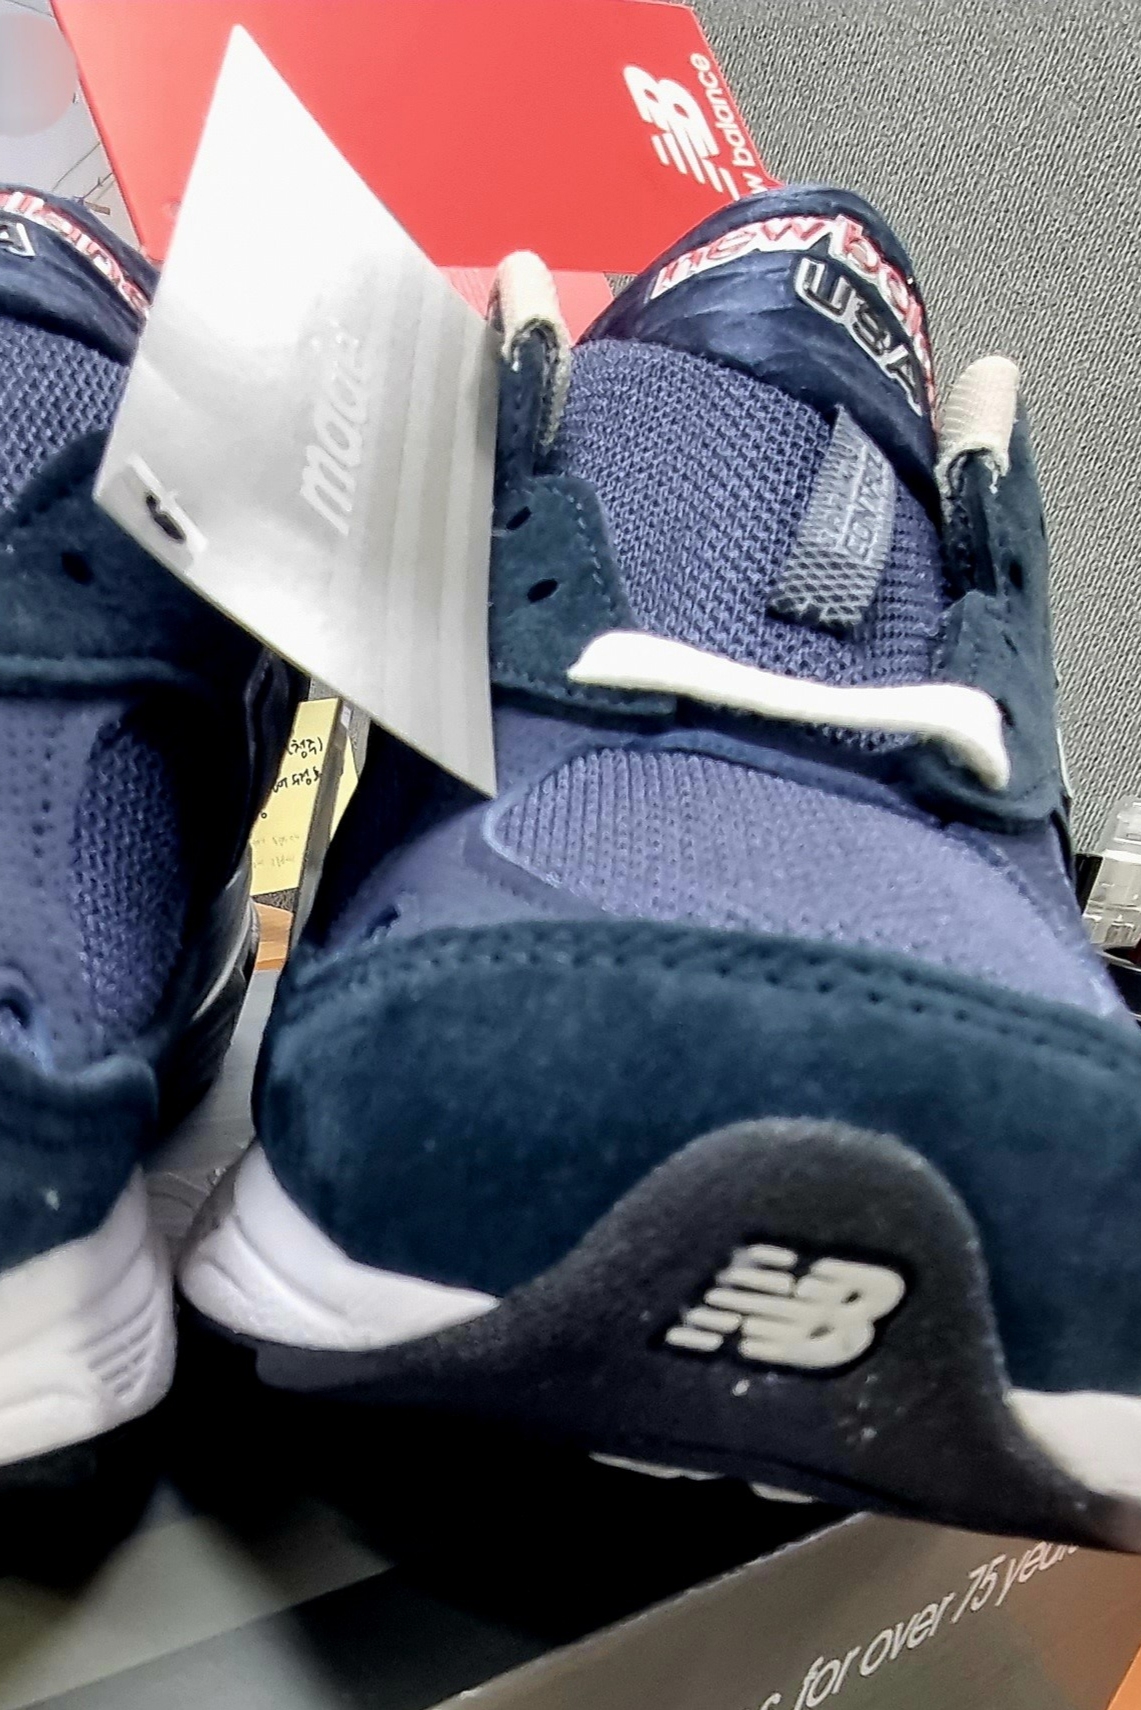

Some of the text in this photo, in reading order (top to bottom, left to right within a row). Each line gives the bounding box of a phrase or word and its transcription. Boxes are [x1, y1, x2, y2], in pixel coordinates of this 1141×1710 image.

[689, 52, 756, 168] balance
[650, 213, 834, 300] new
[793, 255, 923, 418] USA
[792, 1645, 861, 1710] for
[860, 1592, 955, 1678] over
[951, 1553, 1007, 1624] 75
